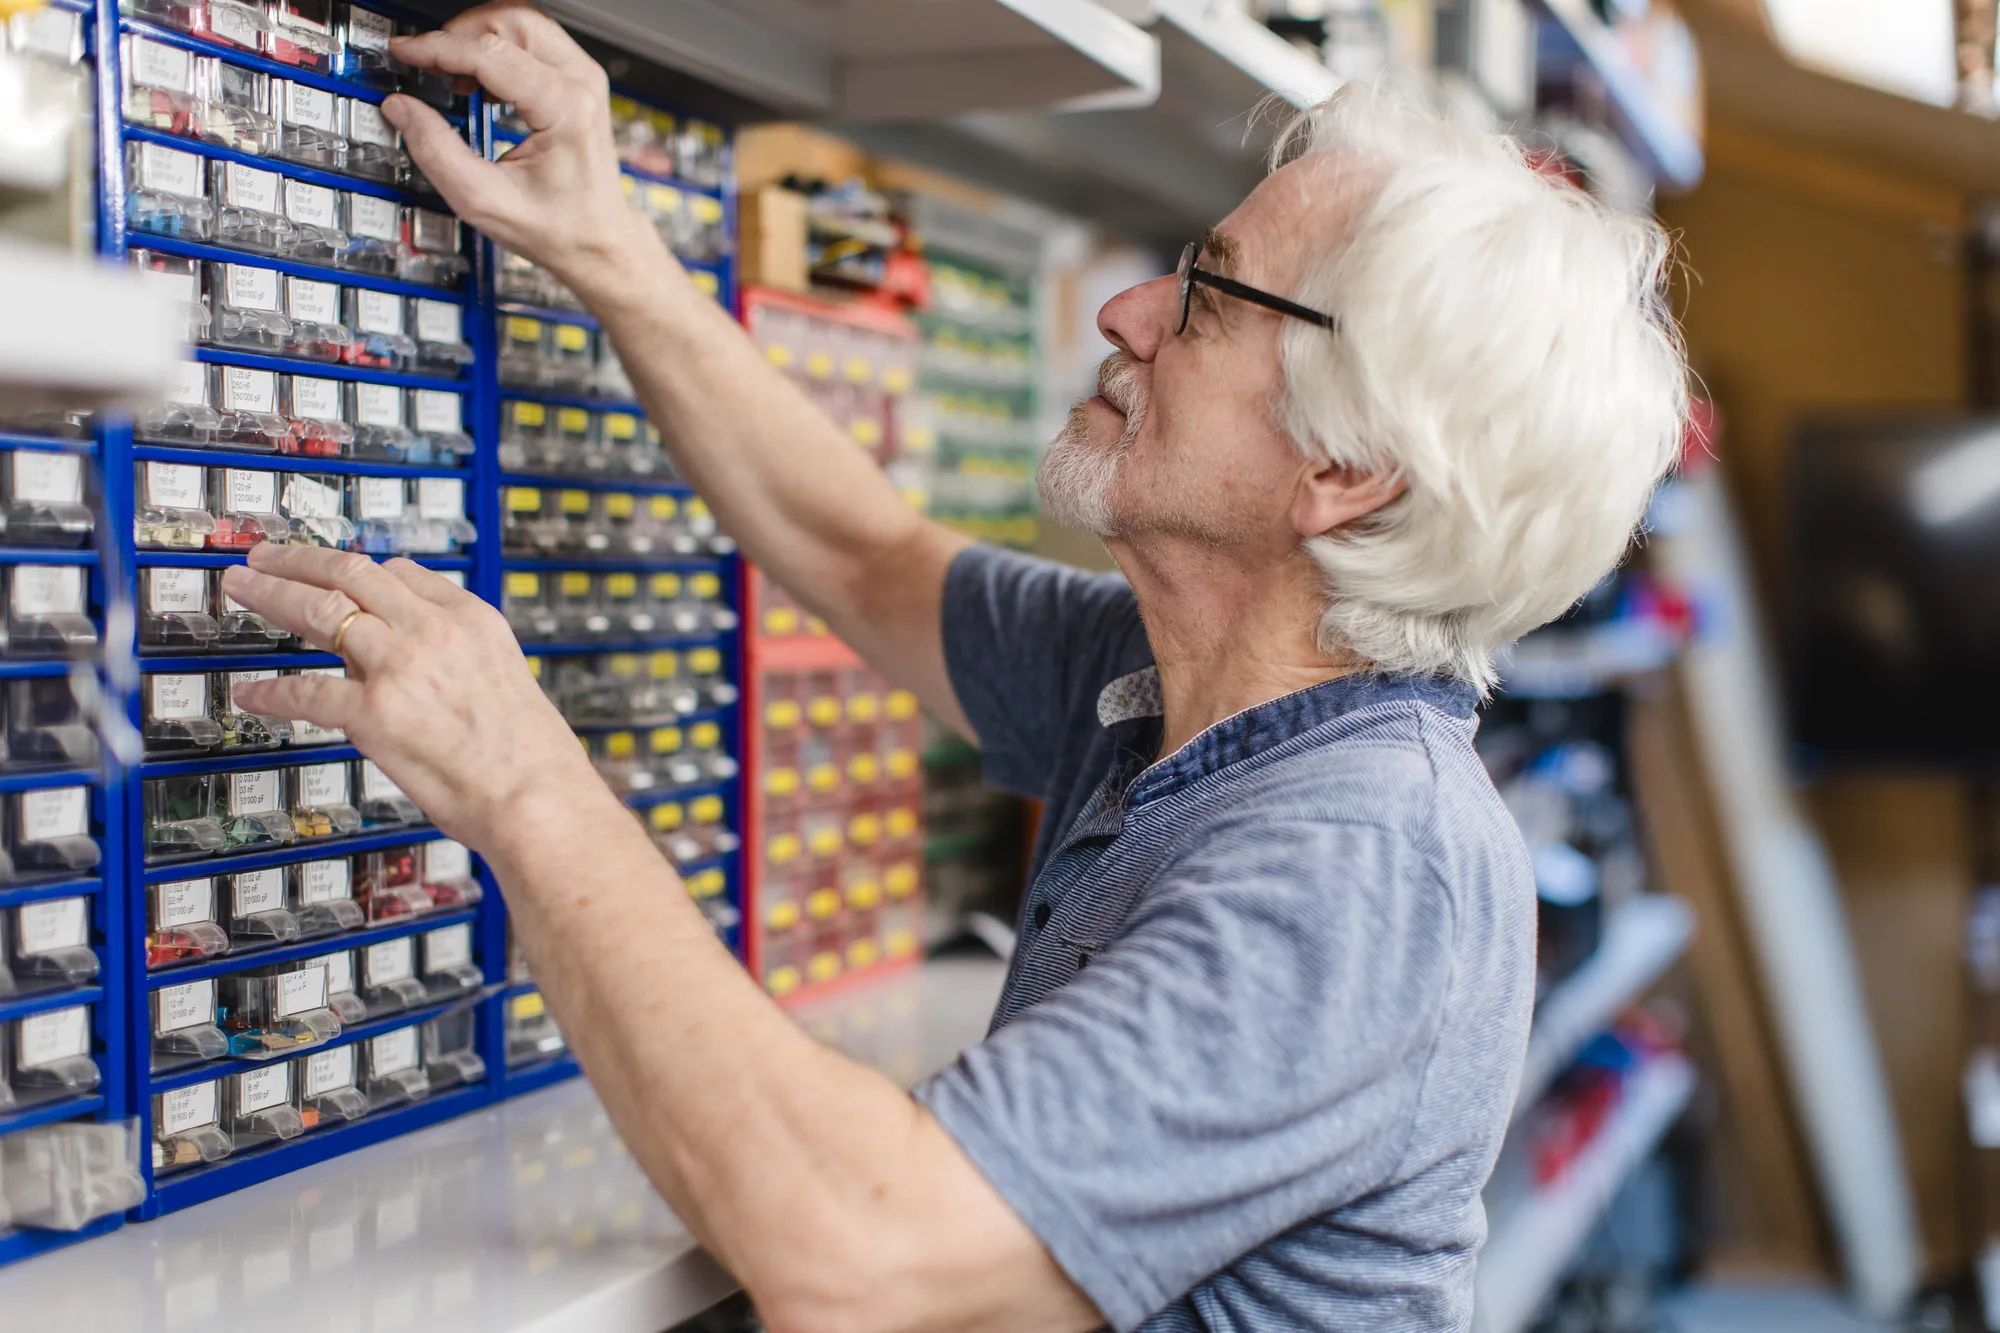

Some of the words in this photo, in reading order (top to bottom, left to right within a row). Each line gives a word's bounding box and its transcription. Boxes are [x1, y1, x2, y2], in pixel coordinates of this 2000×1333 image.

[233, 370, 244, 379] 0.25
[232, 381, 243, 390] 250
[235, 471, 246, 481] 0.12
[235, 483, 244, 491] 120
[239, 774, 254, 783] 0.033
[239, 785, 246, 794] 33
[243, 873, 255, 883] 0.02
[244, 885, 251, 894] 20
[248, 1070, 262, 1081] 0.006
